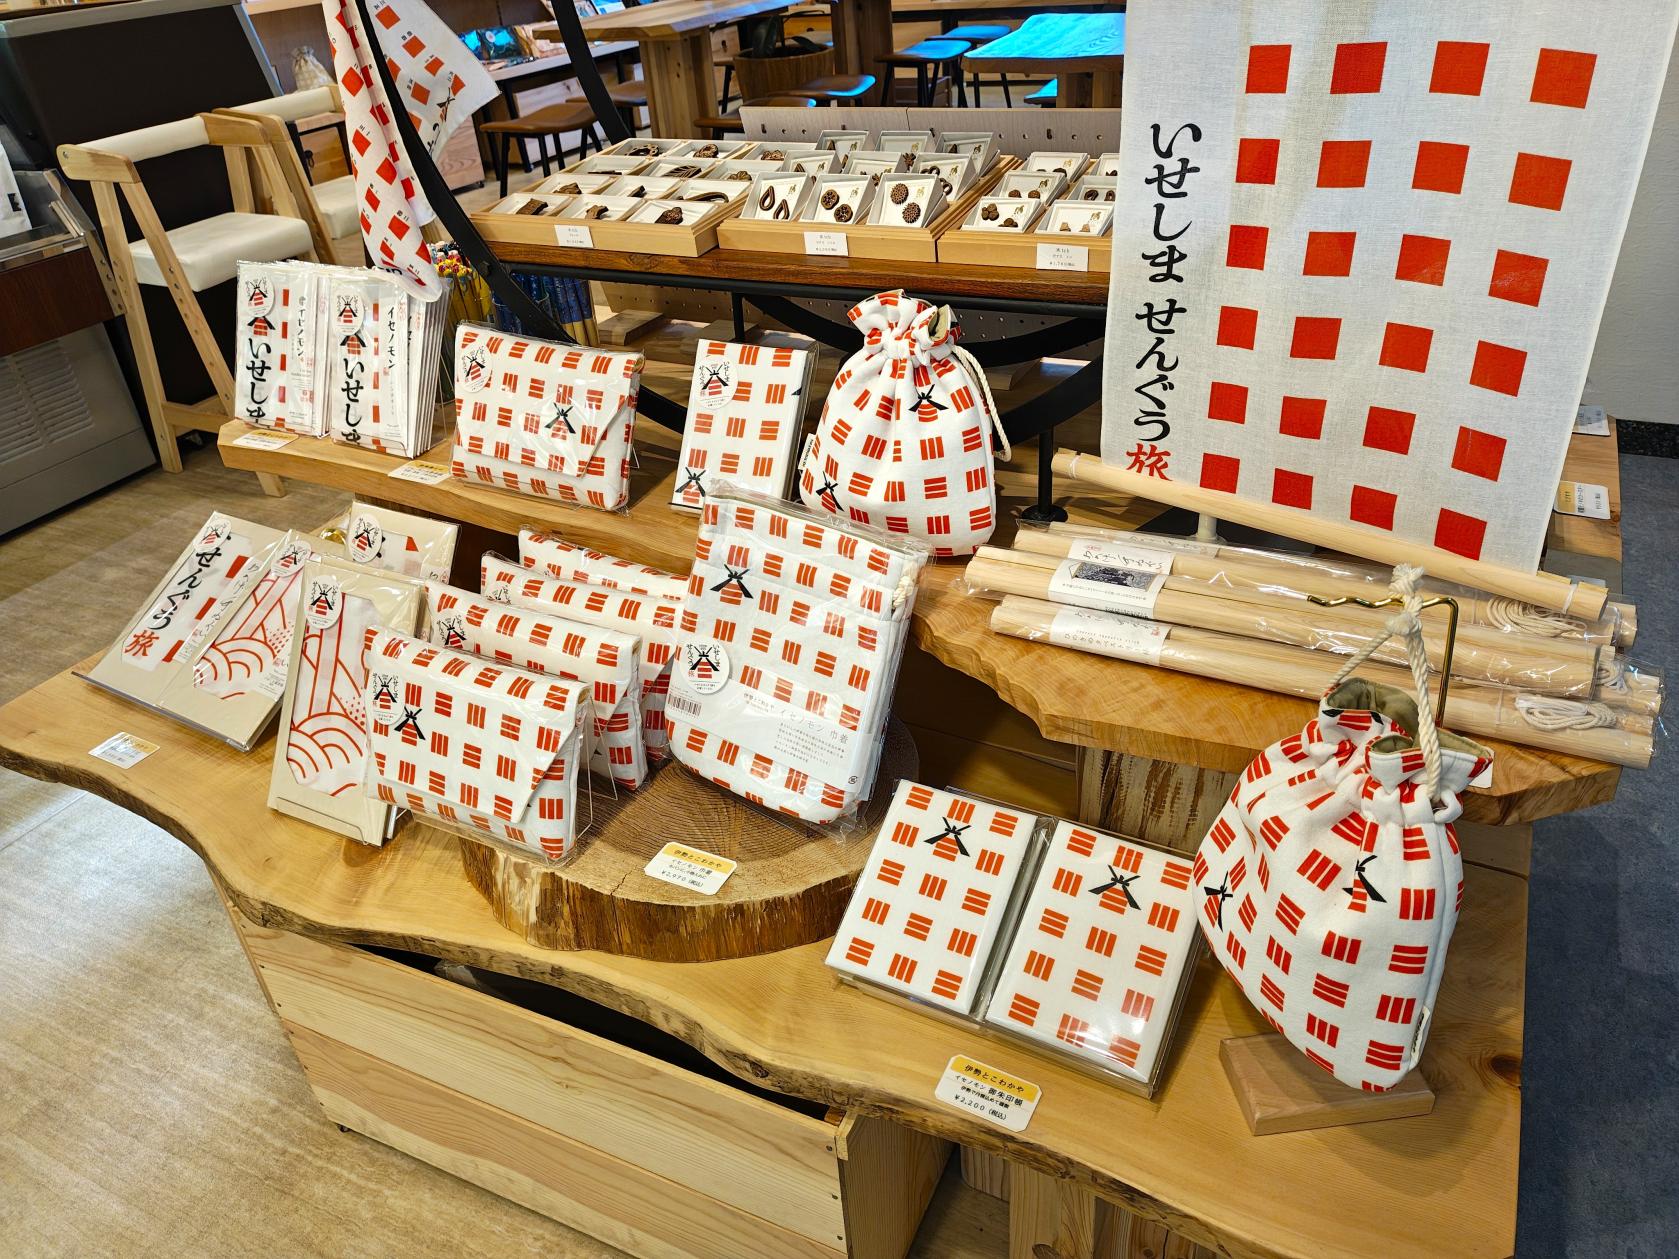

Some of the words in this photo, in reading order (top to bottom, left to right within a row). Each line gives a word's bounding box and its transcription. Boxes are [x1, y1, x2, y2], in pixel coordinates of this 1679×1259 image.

[1141, 122, 1202, 283] いせしま
[964, 1063, 1025, 1093] 伊勢とこわかや
